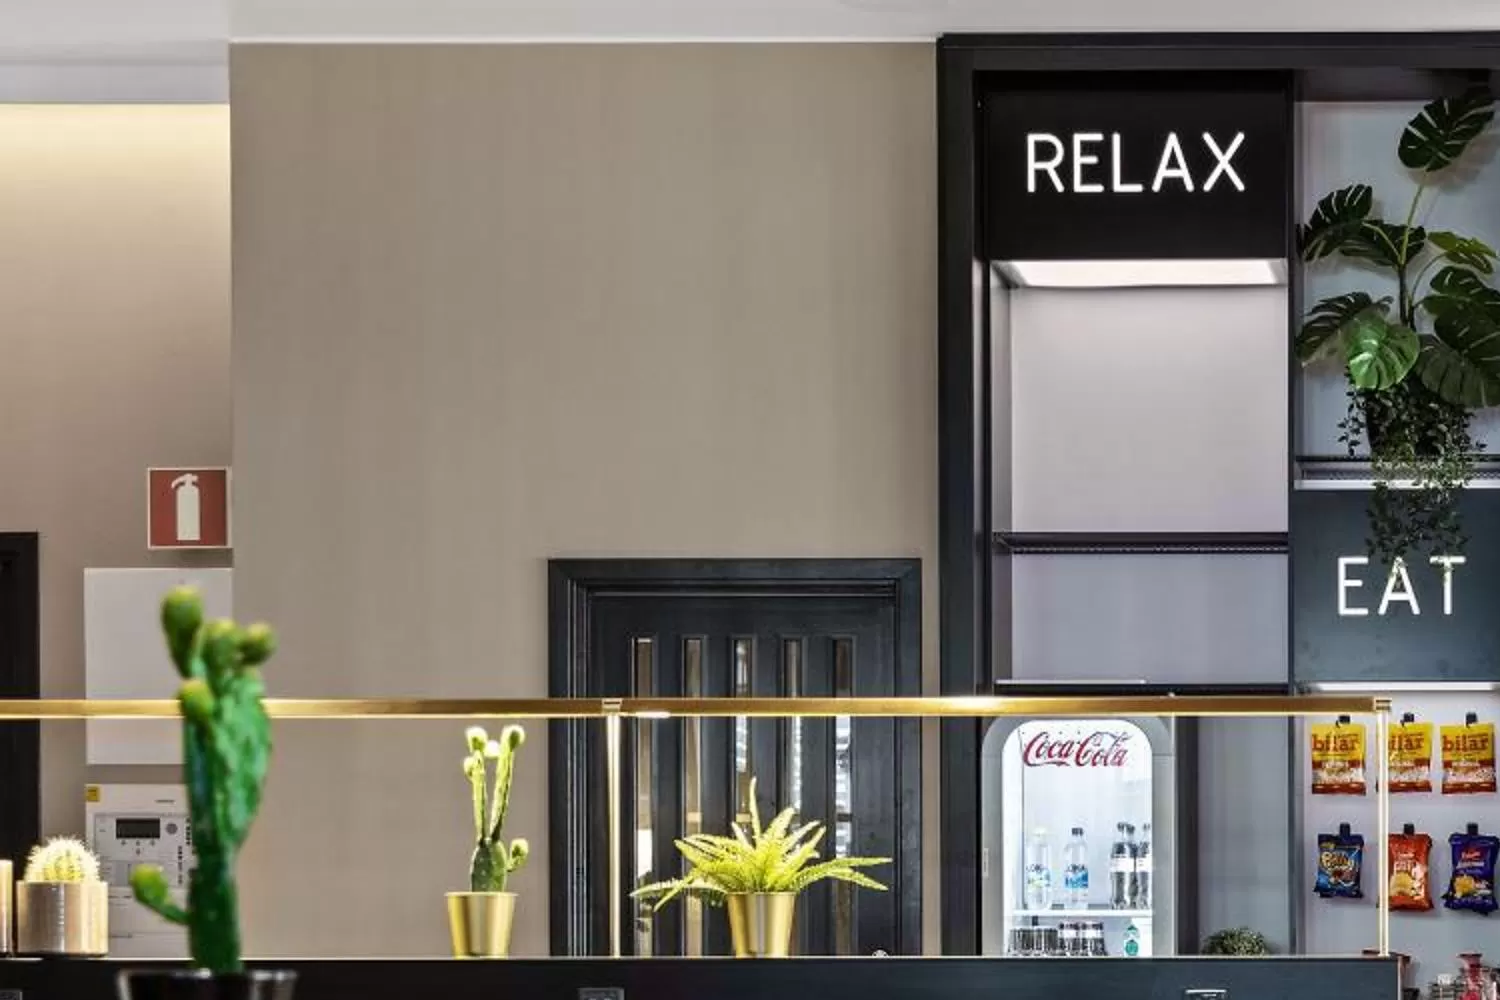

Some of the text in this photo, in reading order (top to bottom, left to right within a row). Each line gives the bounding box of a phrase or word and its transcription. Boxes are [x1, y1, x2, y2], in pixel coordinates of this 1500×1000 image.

[1026, 132, 1246, 193] RELAX
[1337, 555, 1467, 616] EAT
[1023, 731, 1132, 767] Coca-Cola
[1312, 733, 1361, 752] bilar
[1388, 732, 1425, 751] ilar
[1441, 734, 1489, 752] bilar
